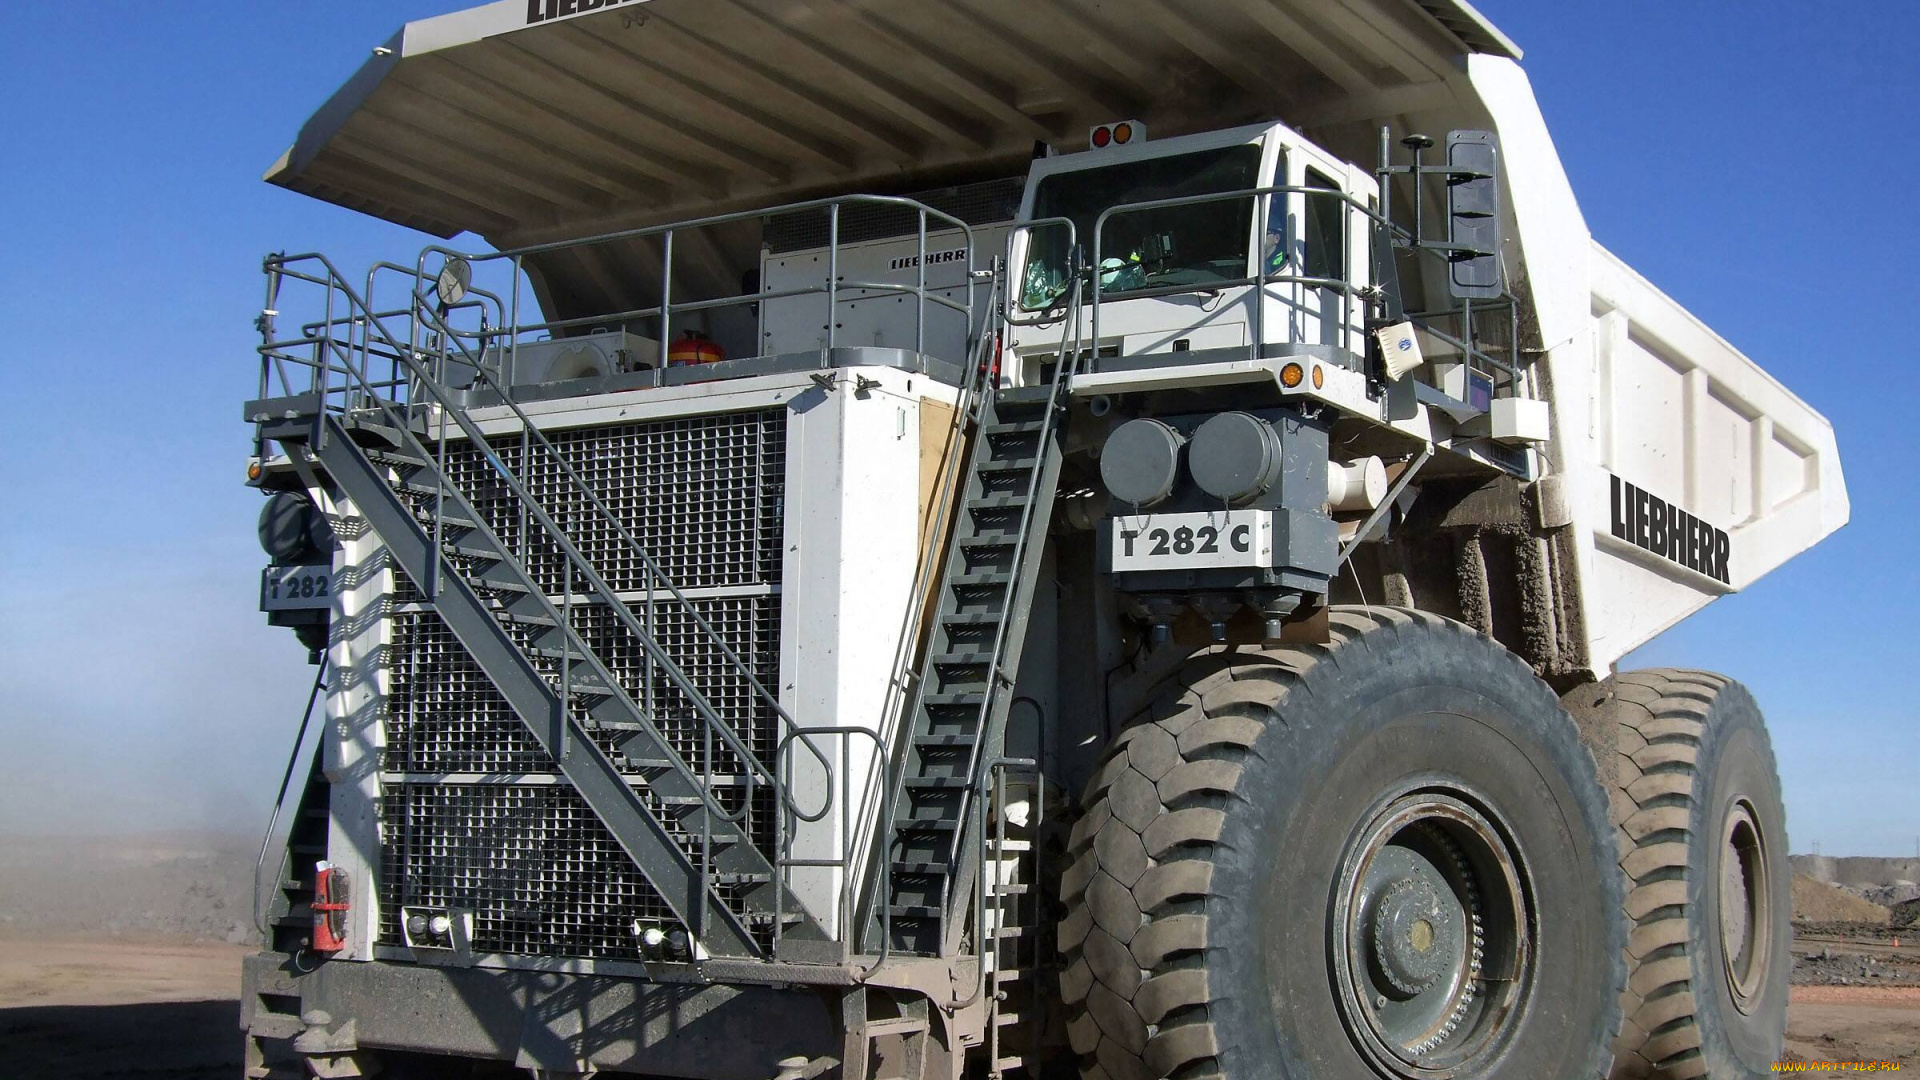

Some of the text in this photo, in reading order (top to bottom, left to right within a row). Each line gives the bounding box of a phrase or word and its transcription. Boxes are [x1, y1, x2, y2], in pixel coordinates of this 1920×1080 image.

[891, 249, 966, 270] LIEBHERR
[1120, 524, 1250, 556] T 282 C
[1610, 473, 1730, 585] LIEBHERR
[269, 575, 329, 599] T 282
